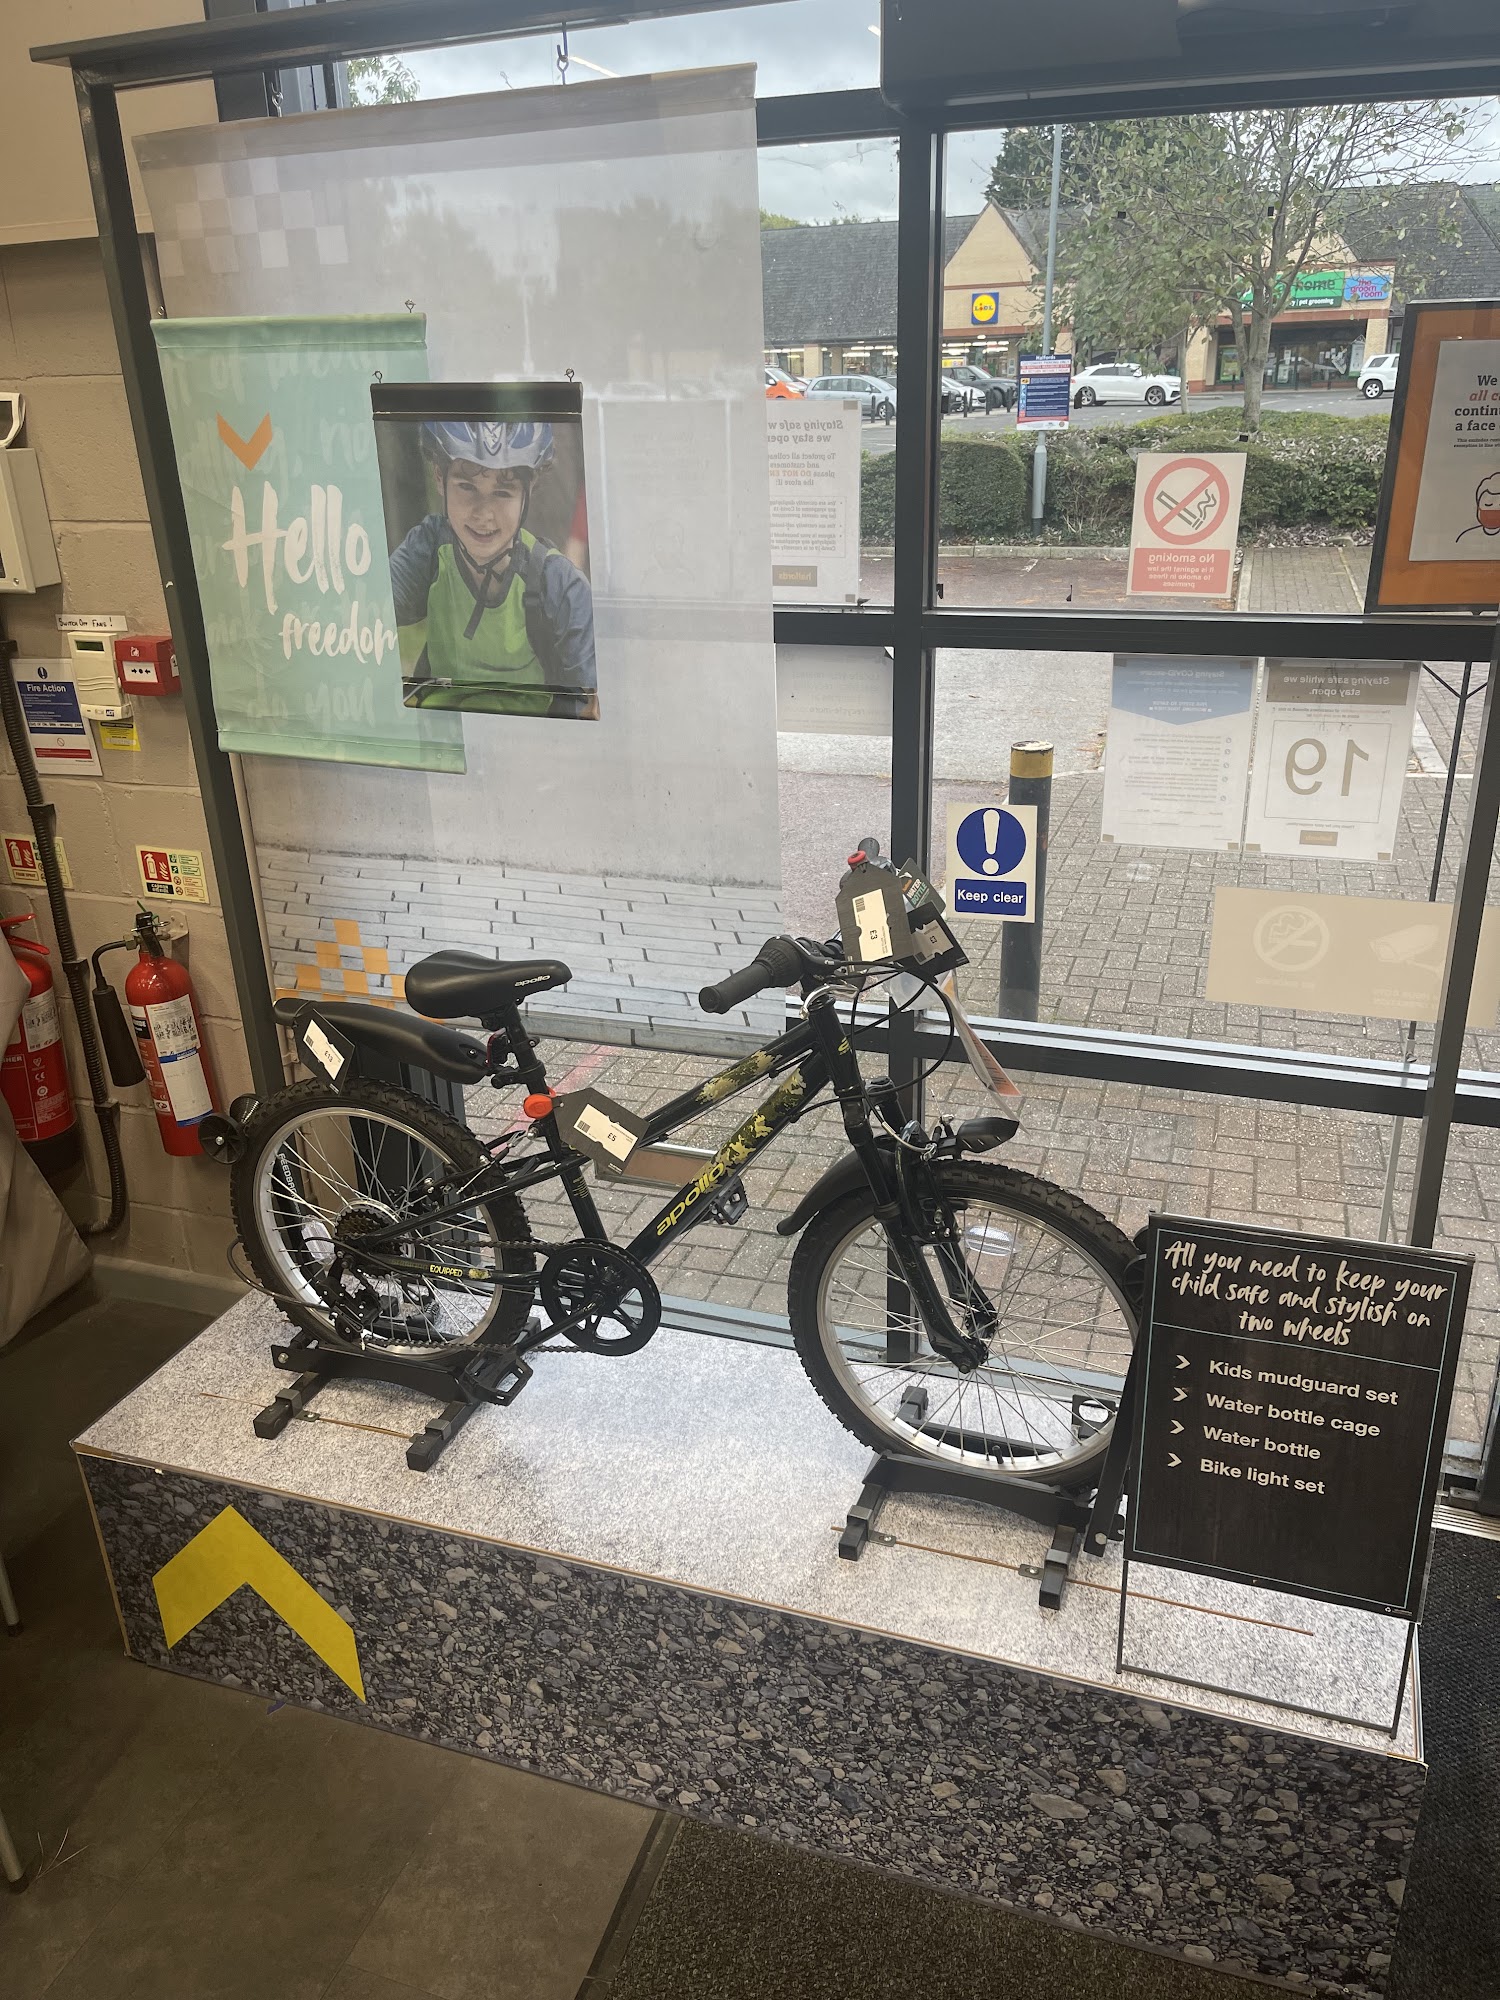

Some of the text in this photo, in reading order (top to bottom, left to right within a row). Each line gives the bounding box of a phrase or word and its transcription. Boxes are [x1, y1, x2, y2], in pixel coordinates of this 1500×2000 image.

[1295, 279, 1336, 291] home
[1350, 285, 1377, 294] groom
[1360, 290, 1383, 298] room
[1308, 298, 1334, 306] grooming
[1477, 375, 1498, 386] We
[1470, 390, 1488, 401] all
[1455, 405, 1500, 416] contin
[1455, 420, 1496, 431] a face
[222, 480, 372, 615] Hello
[26, 684, 66, 692] Fire Action
[906, 878, 922, 899] WATER
[911, 882, 928, 905] BOTTLE
[957, 889, 1024, 904] Keep clear
[870, 929, 878, 940] £3
[514, 975, 551, 987] apollo
[607, 1132, 617, 1142] £5
[656, 1162, 725, 1237] apollo
[429, 1264, 464, 1278] EQUIPPED
[1165, 1240, 1448, 1302] All you need to keep your
[1171, 1271, 1431, 1327] child safe and stylish on
[1239, 1310, 1352, 1346] two wheels
[1209, 1360, 1399, 1406] Kids mudguard set
[1206, 1393, 1381, 1437] Water bottle cage
[1203, 1425, 1321, 1460] Water bottle
[1200, 1458, 1326, 1495] Bike light set
